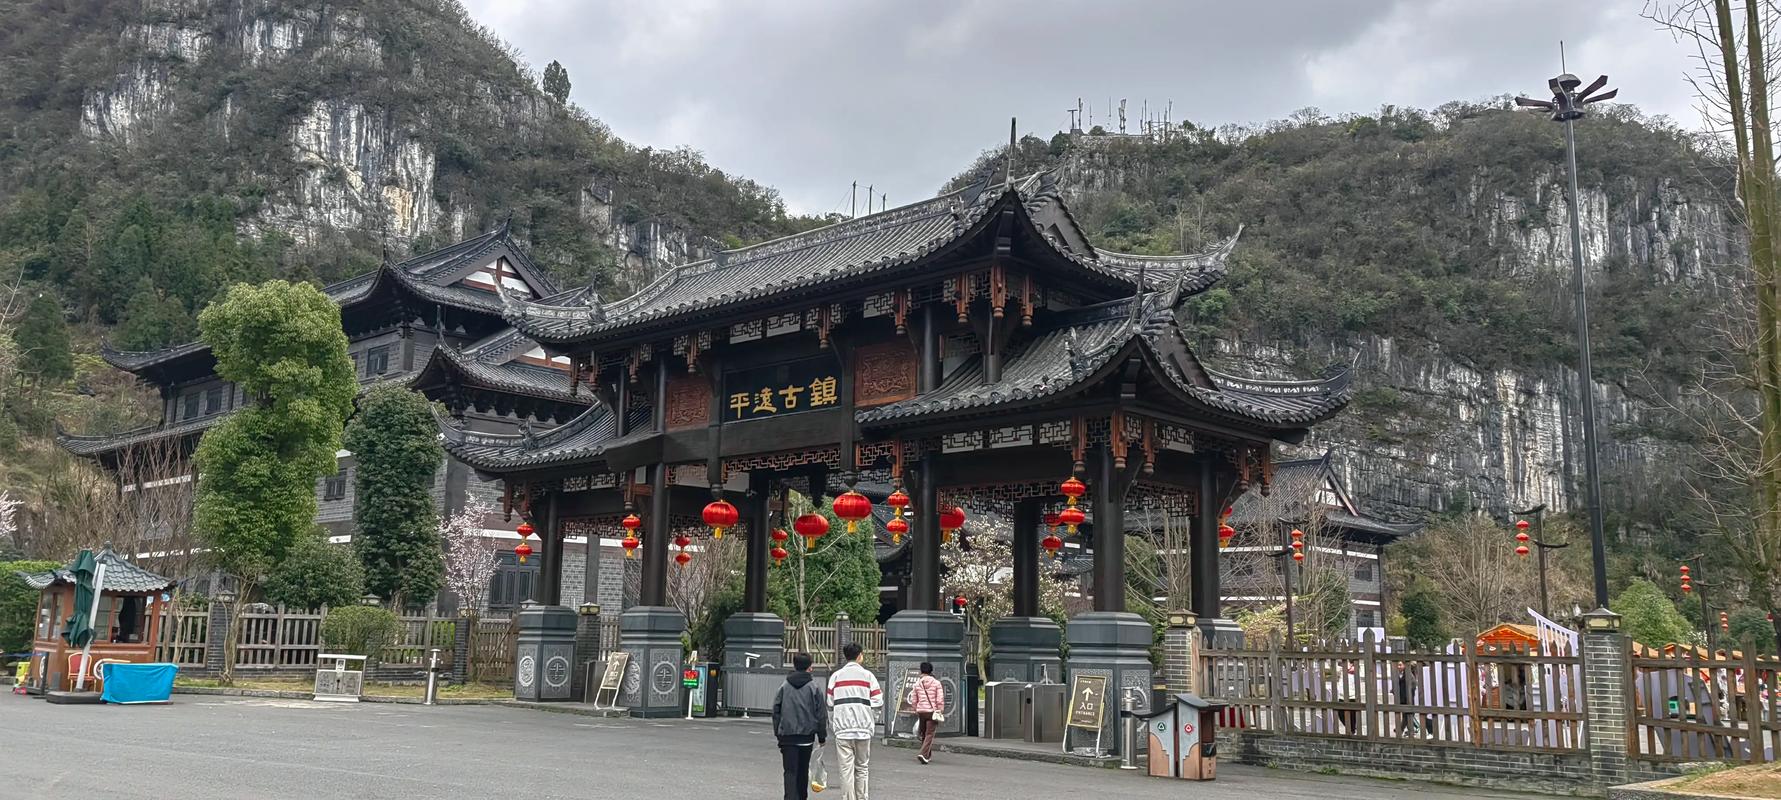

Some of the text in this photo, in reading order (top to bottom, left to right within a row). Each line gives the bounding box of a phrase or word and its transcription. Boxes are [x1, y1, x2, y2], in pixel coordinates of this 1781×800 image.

[729, 376, 838, 419] 平遠古鎮
[1079, 701, 1094, 710] 入口
